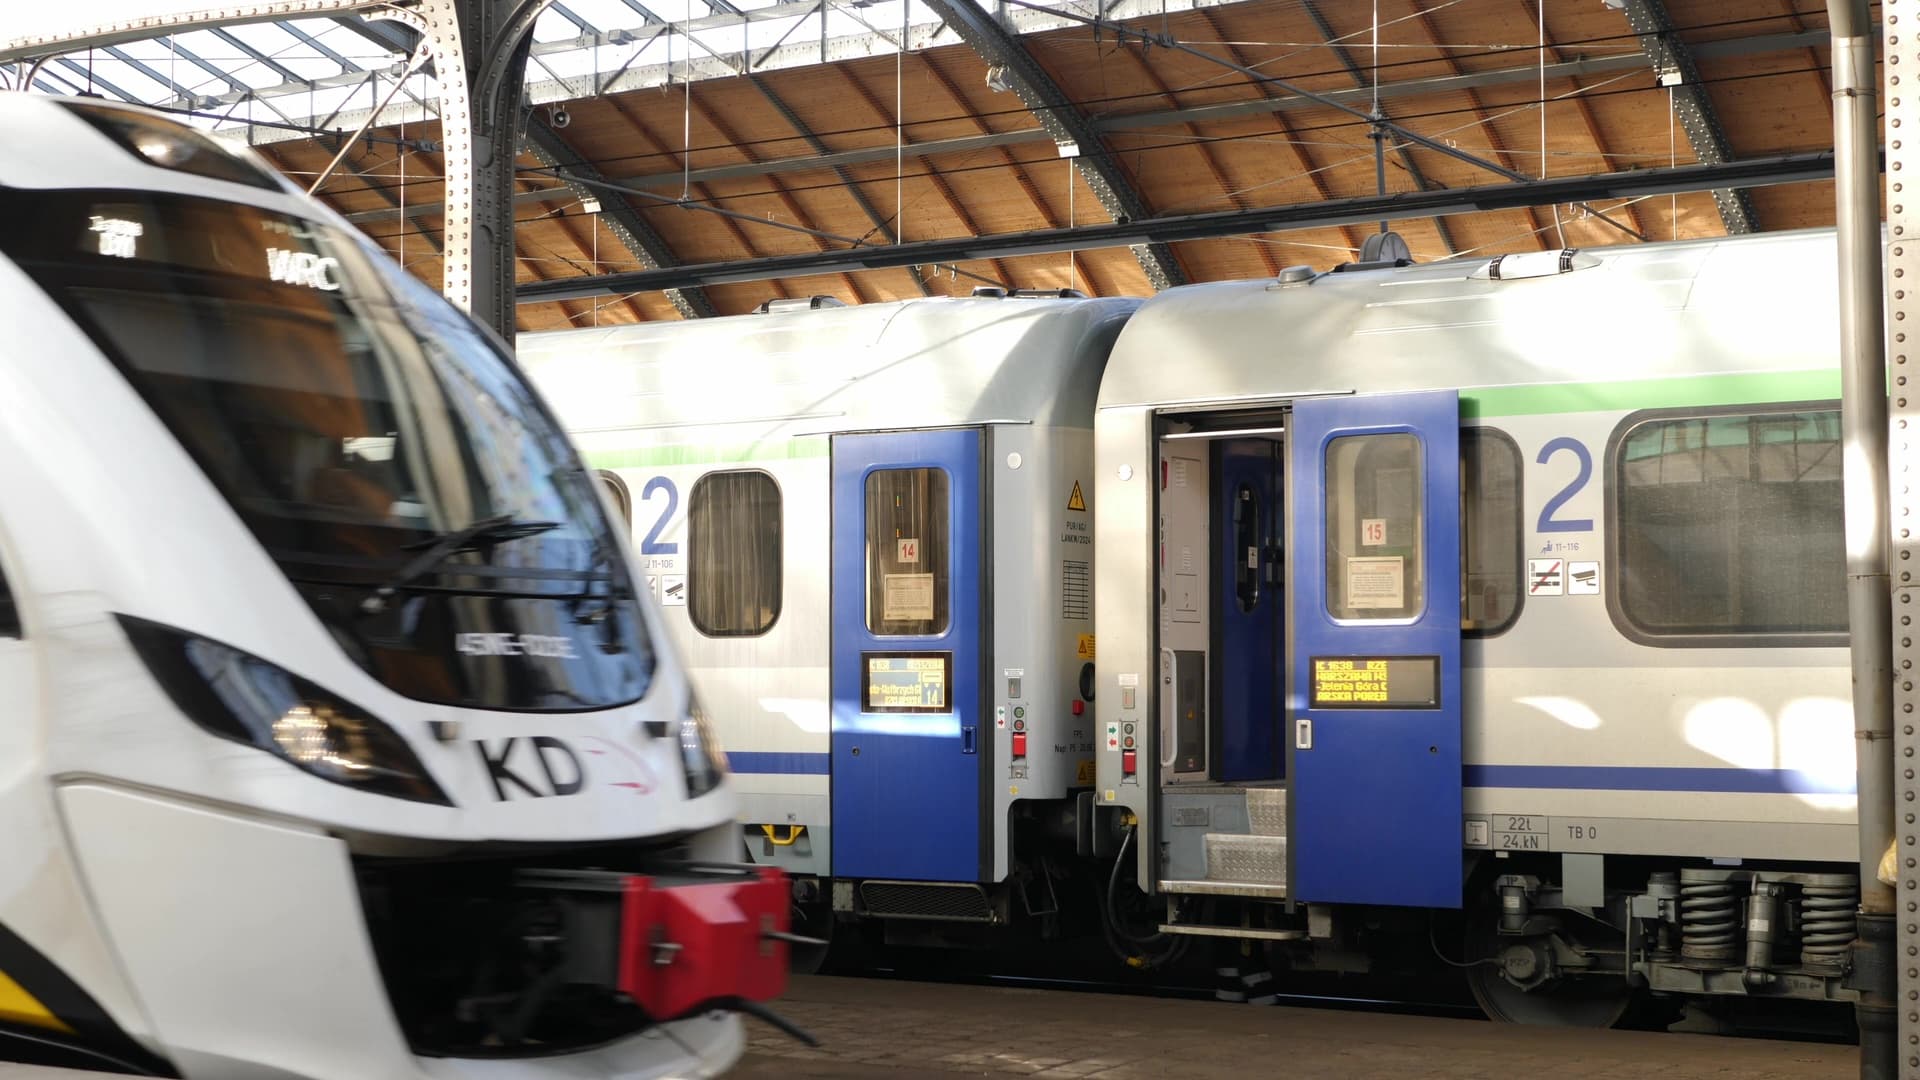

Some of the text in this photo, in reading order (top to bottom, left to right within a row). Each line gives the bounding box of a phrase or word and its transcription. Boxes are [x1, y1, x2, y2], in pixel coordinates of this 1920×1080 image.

[266, 248, 340, 290] WRC
[1536, 437, 1593, 533] 2
[641, 476, 679, 555] 2
[1367, 524, 1382, 540] 15
[902, 543, 915, 559] 14
[1555, 542, 1580, 552] 11-116
[652, 560, 674, 569] 11-106
[473, 736, 583, 801] KD
[1508, 817, 1532, 831] 22t
[1567, 826, 1583, 839] TB
